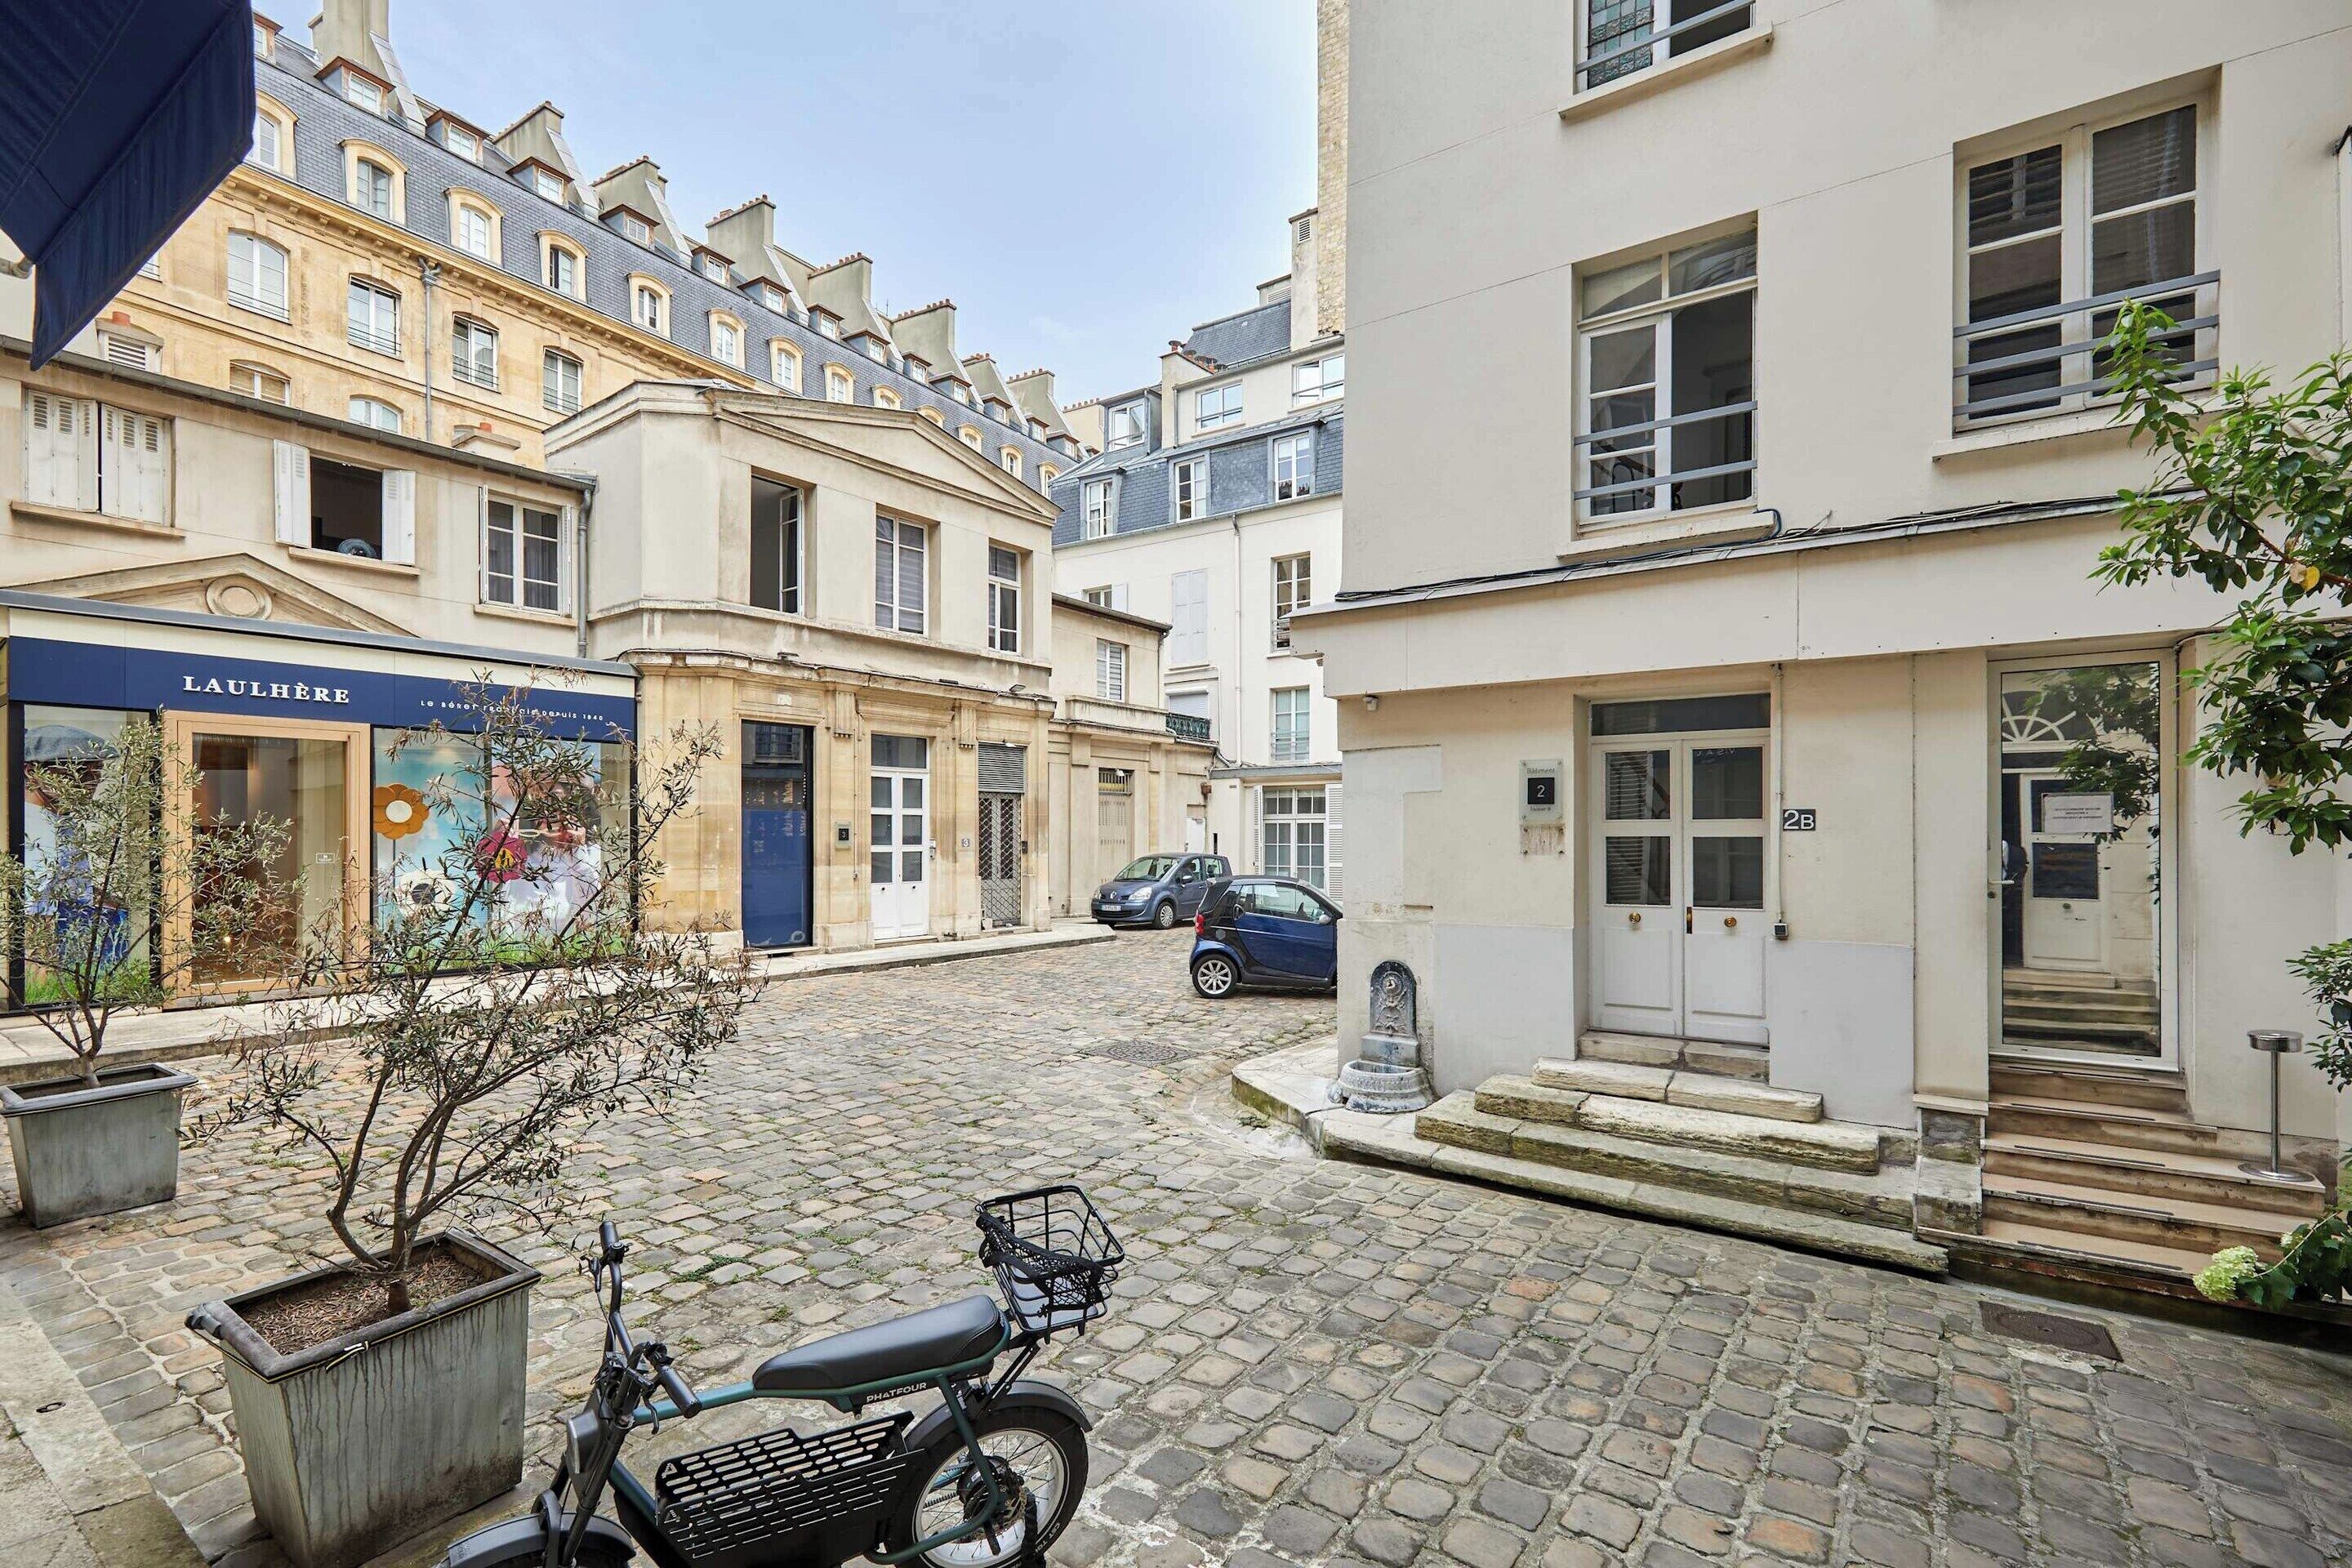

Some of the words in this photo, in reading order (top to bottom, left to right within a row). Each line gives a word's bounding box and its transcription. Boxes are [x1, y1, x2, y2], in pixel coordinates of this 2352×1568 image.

[183, 675, 350, 703] LAULHÈRE
[1537, 785, 1545, 798] 2
[1784, 809, 1815, 830] 2B
[866, 1382, 928, 1403] PHATFOUR
